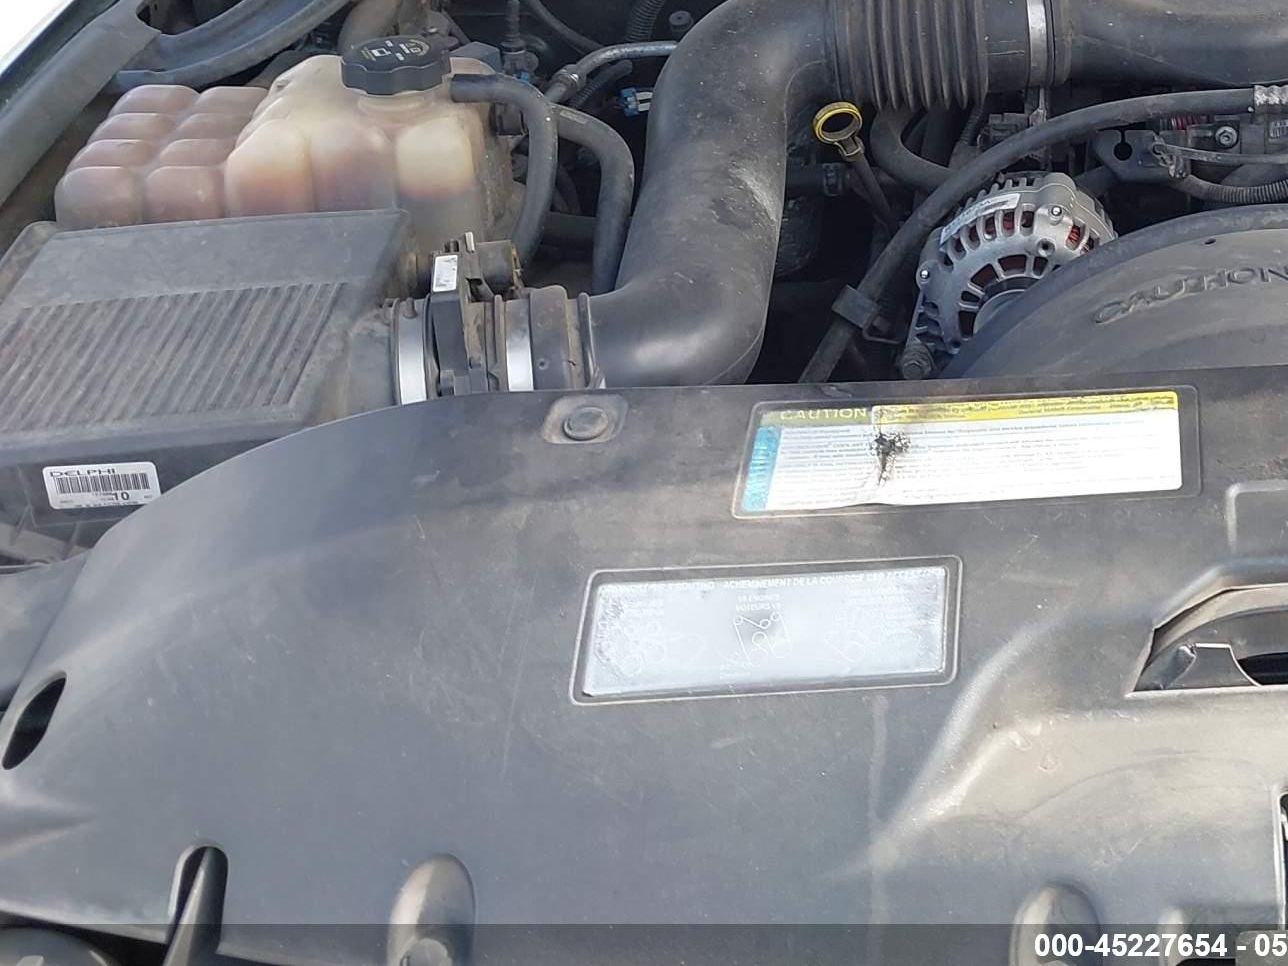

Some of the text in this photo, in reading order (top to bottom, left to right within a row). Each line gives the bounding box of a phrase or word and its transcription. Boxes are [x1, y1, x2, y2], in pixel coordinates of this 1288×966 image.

[780, 407, 868, 421] CAUTION
[49, 468, 116, 478] DELPHI
[113, 491, 130, 501] 10
